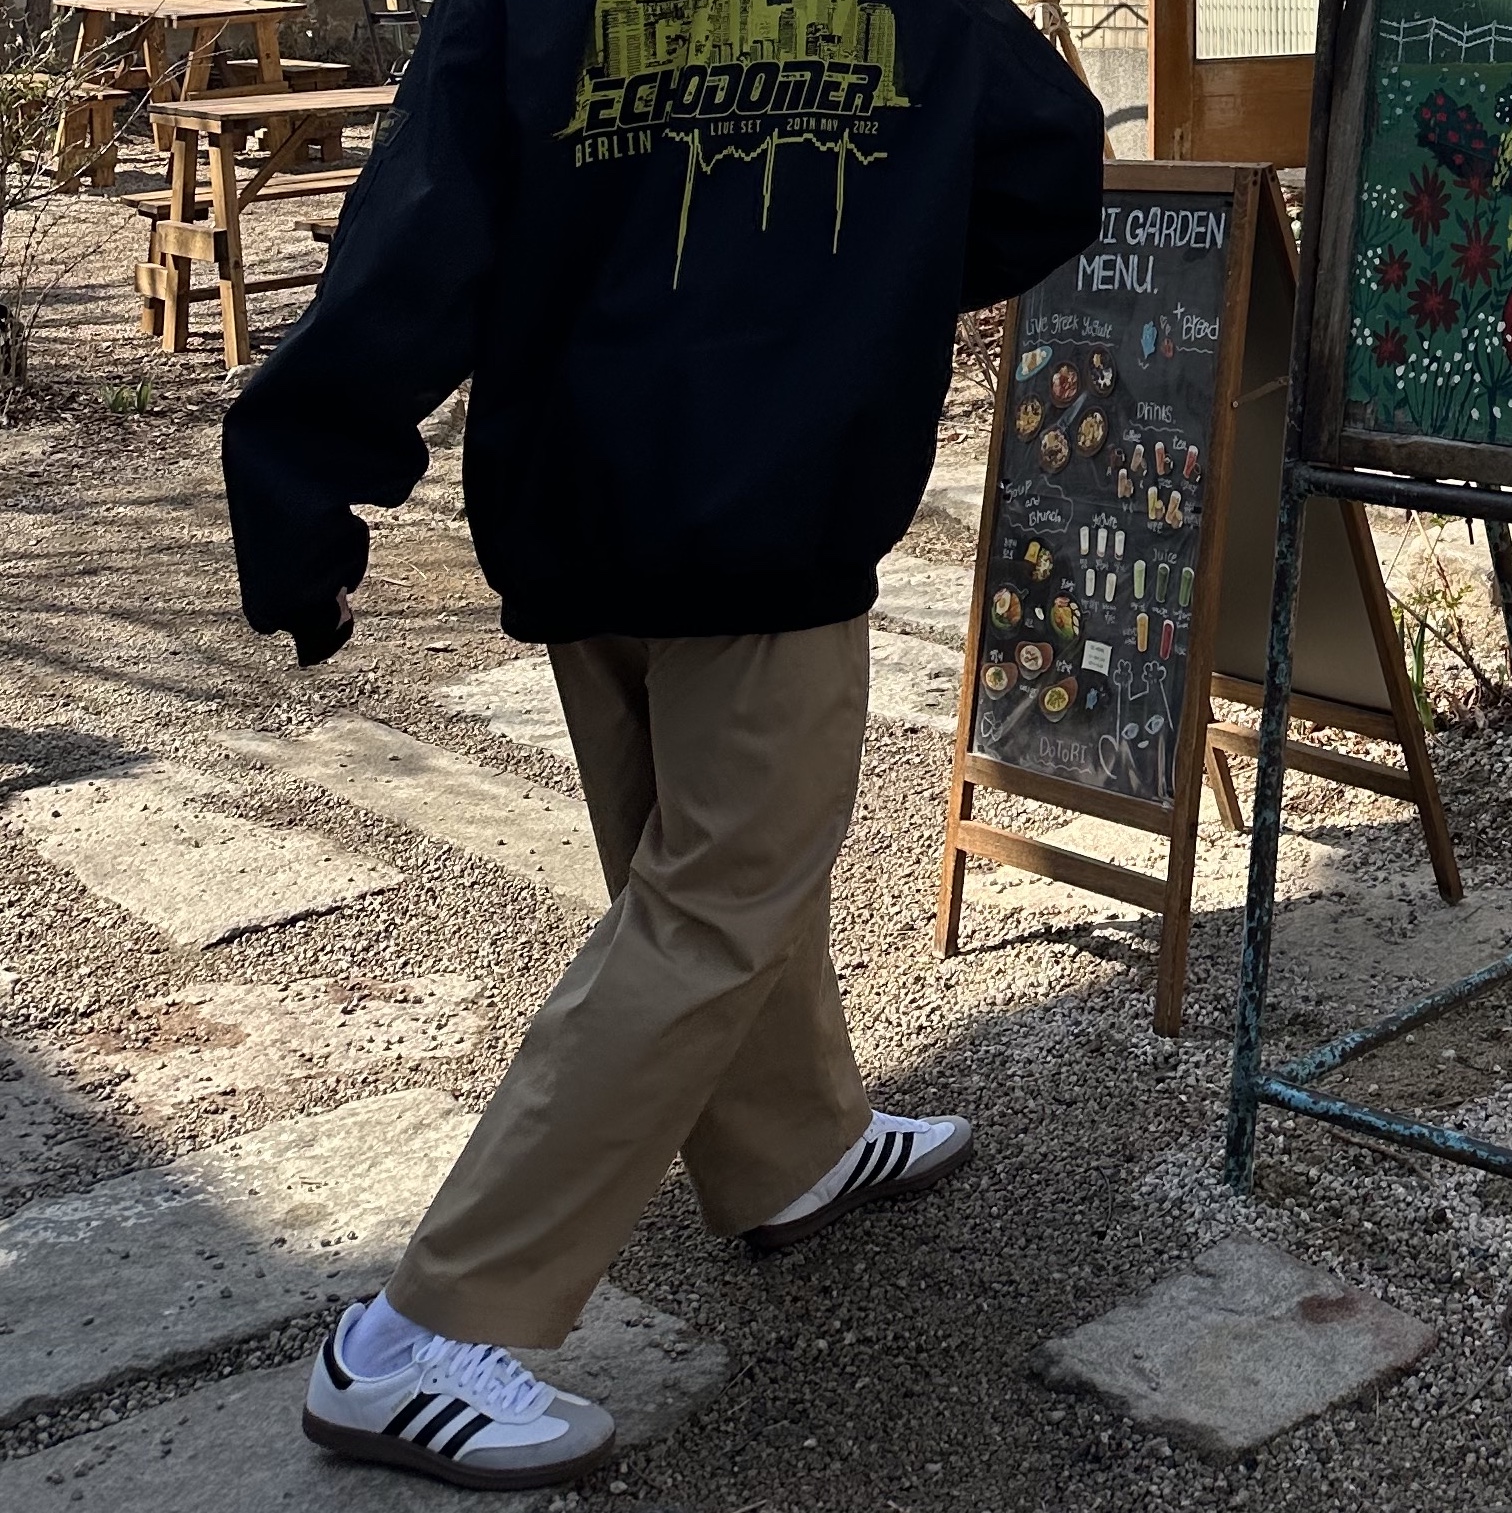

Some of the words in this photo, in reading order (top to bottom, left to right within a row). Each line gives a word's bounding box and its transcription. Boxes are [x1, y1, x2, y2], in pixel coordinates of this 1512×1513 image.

[710, 120, 735, 136] LIVE
[740, 119, 762, 133] SET
[786, 118, 817, 131] 20TH
[820, 118, 839, 132] MAY
[853, 120, 880, 134] 2022
[575, 129, 652, 167] BERLIN
[1125, 206, 1226, 249] GARDEN
